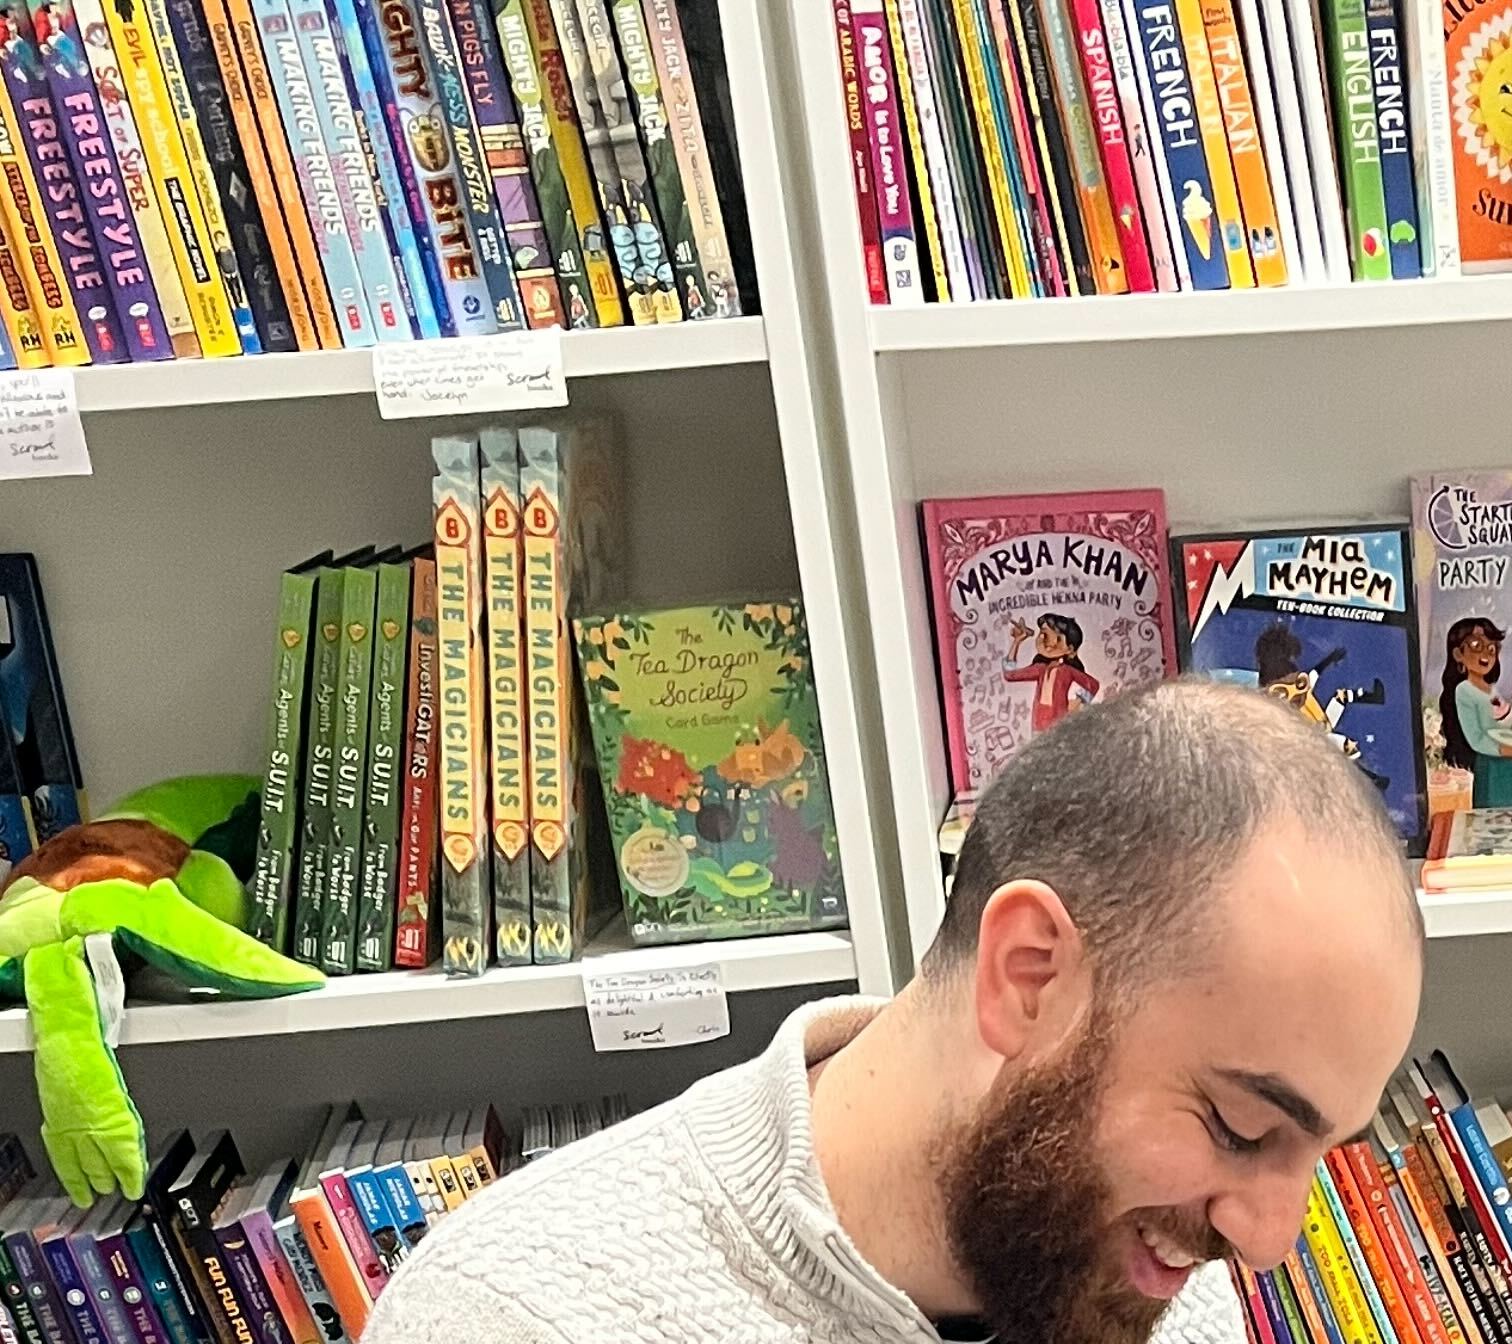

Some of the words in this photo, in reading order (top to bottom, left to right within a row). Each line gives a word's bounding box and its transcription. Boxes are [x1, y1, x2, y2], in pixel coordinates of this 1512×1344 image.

[313, 36, 352, 143] MAKING
[341, 142, 381, 233] FRIENDS
[501, 15, 537, 94] MIGHTY
[521, 102, 551, 155] JACK
[619, 5, 652, 87] MIGHTY
[637, 93, 667, 147] JACK
[1082, 28, 1125, 145] SPANISH
[1142, 4, 1198, 149] FRENCH
[1208, 35, 1258, 154] ITALIAN
[1341, 31, 1380, 164] ENGLISH
[1369, 28, 1408, 154] FRENCH
[22, 97, 103, 291] FREESTYLE
[64, 92, 145, 287] FREESTYLE
[276, 37, 317, 146] MAKING
[304, 144, 346, 236] FRIENDS
[1454, 488, 1477, 503] THE
[442, 563, 465, 622] THE
[490, 552, 514, 612] THE
[529, 552, 553, 612] THE
[956, 540, 1054, 606] MARYA
[1062, 536, 1149, 597] KHAN
[1438, 555, 1507, 588] PARTY
[628, 653, 670, 676] Tea
[675, 649, 759, 680] Dragon
[649, 677, 749, 711] Society
[674, 627, 704, 646] The
[443, 639, 469, 821] MAGICIANS
[493, 627, 520, 810] MAGICIANS
[532, 627, 557, 810] MAGICIANS
[15, 1301, 36, 1327] THE
[76, 1308, 98, 1336] THE
[132, 1306, 153, 1333] THE
[204, 1255, 228, 1287] FUN
[217, 1285, 241, 1317] FUN
